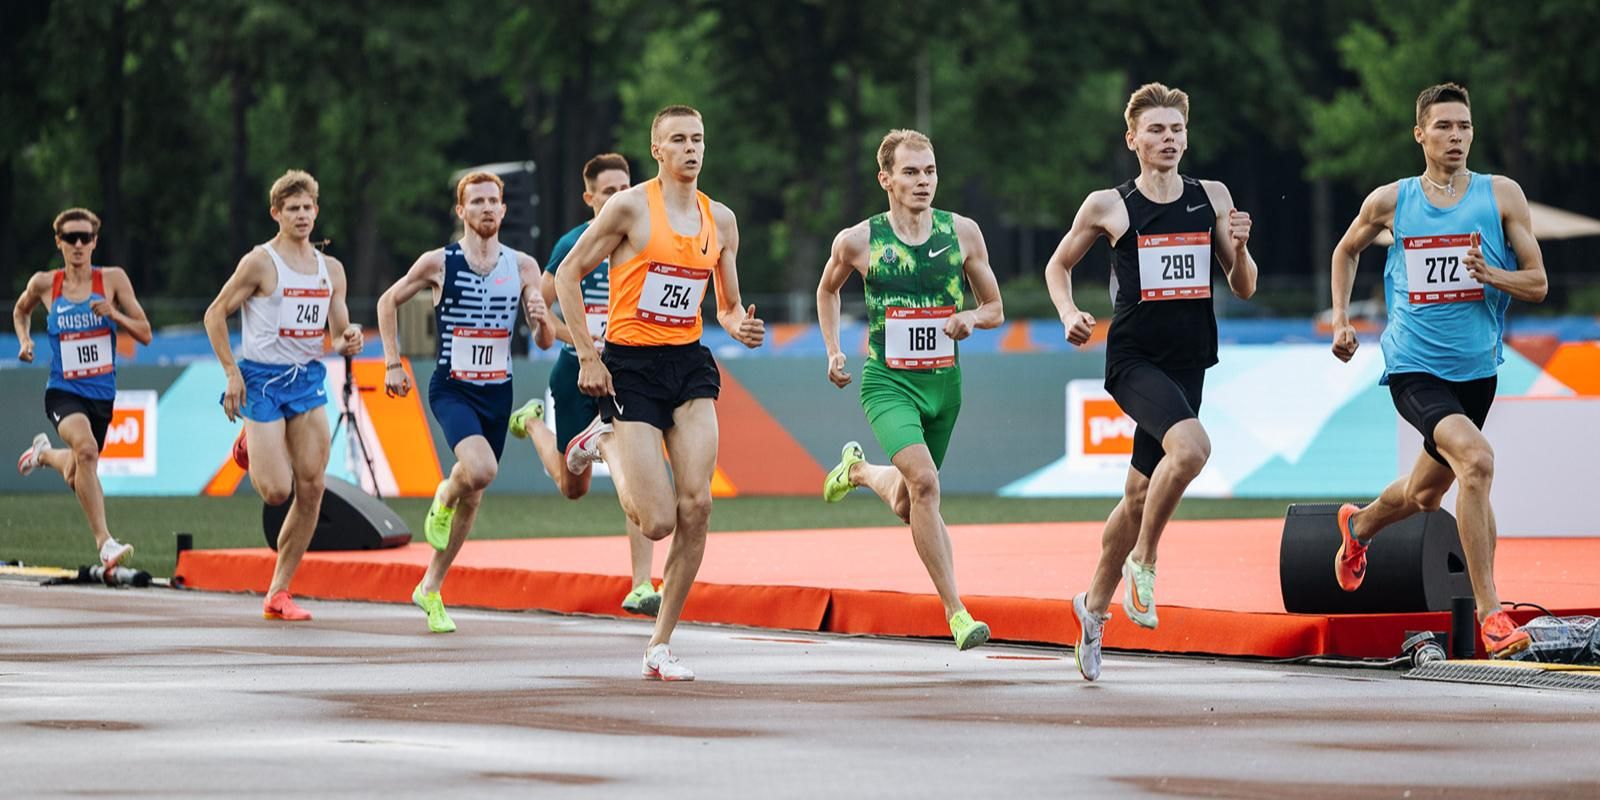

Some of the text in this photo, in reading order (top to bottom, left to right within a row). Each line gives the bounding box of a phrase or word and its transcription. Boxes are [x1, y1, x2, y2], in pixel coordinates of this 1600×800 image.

[1161, 253, 1195, 280] 299
[1425, 256, 1460, 284] 272
[659, 283, 691, 310] 254
[296, 304, 319, 324] 248
[908, 326, 936, 351] 168
[77, 344, 99, 364] 196
[471, 345, 493, 365] 170
